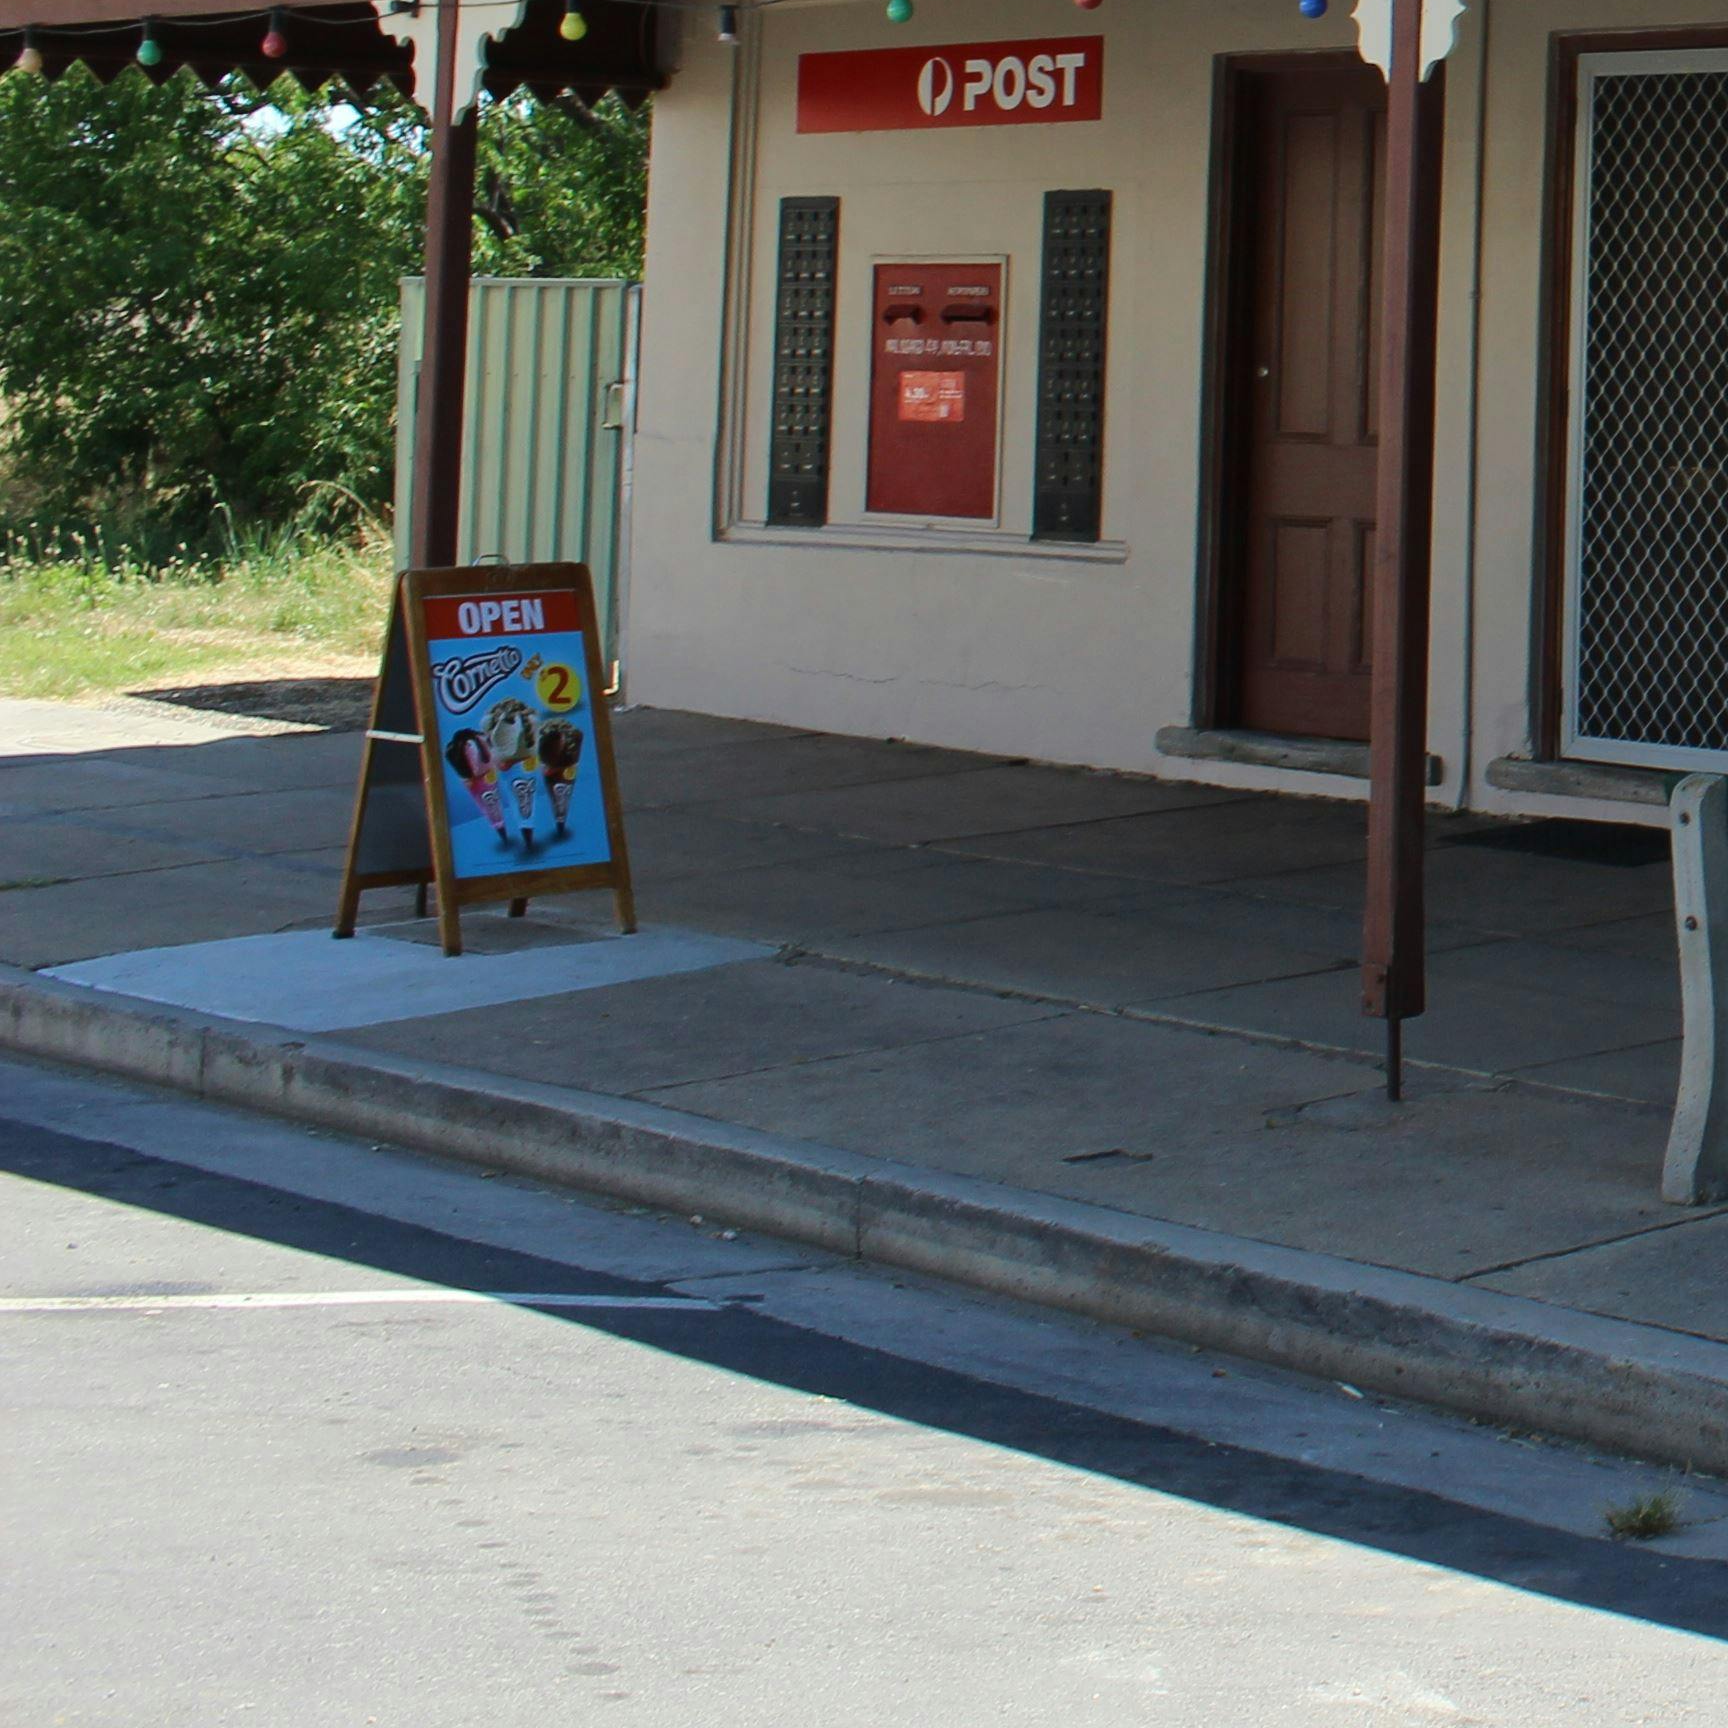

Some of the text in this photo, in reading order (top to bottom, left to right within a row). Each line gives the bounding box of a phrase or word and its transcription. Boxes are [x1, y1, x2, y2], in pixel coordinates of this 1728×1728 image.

[964, 53, 1085, 111] POST
[458, 598, 544, 635] OPEN
[433, 647, 522, 715] Cornetto
